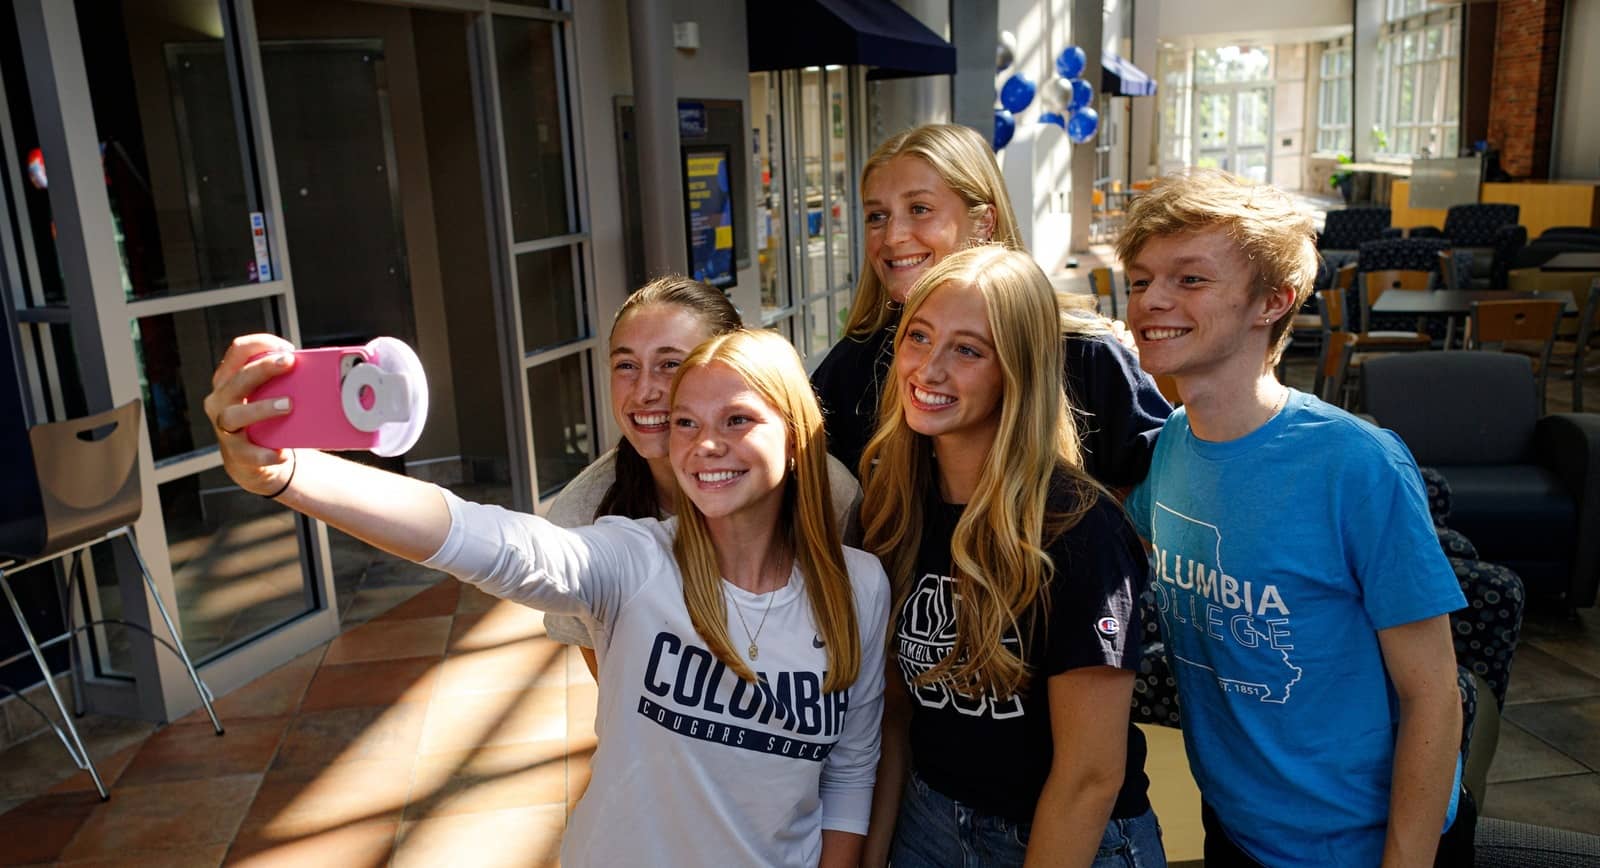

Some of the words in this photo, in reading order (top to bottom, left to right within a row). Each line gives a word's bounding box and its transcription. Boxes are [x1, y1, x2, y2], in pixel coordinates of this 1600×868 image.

[1152, 543, 1290, 616] LUMBIA
[1151, 581, 1294, 651] OLLEGE
[1234, 684, 1260, 696] 1851
[643, 700, 745, 745] COUGARS
[767, 736, 831, 759] SOCC
